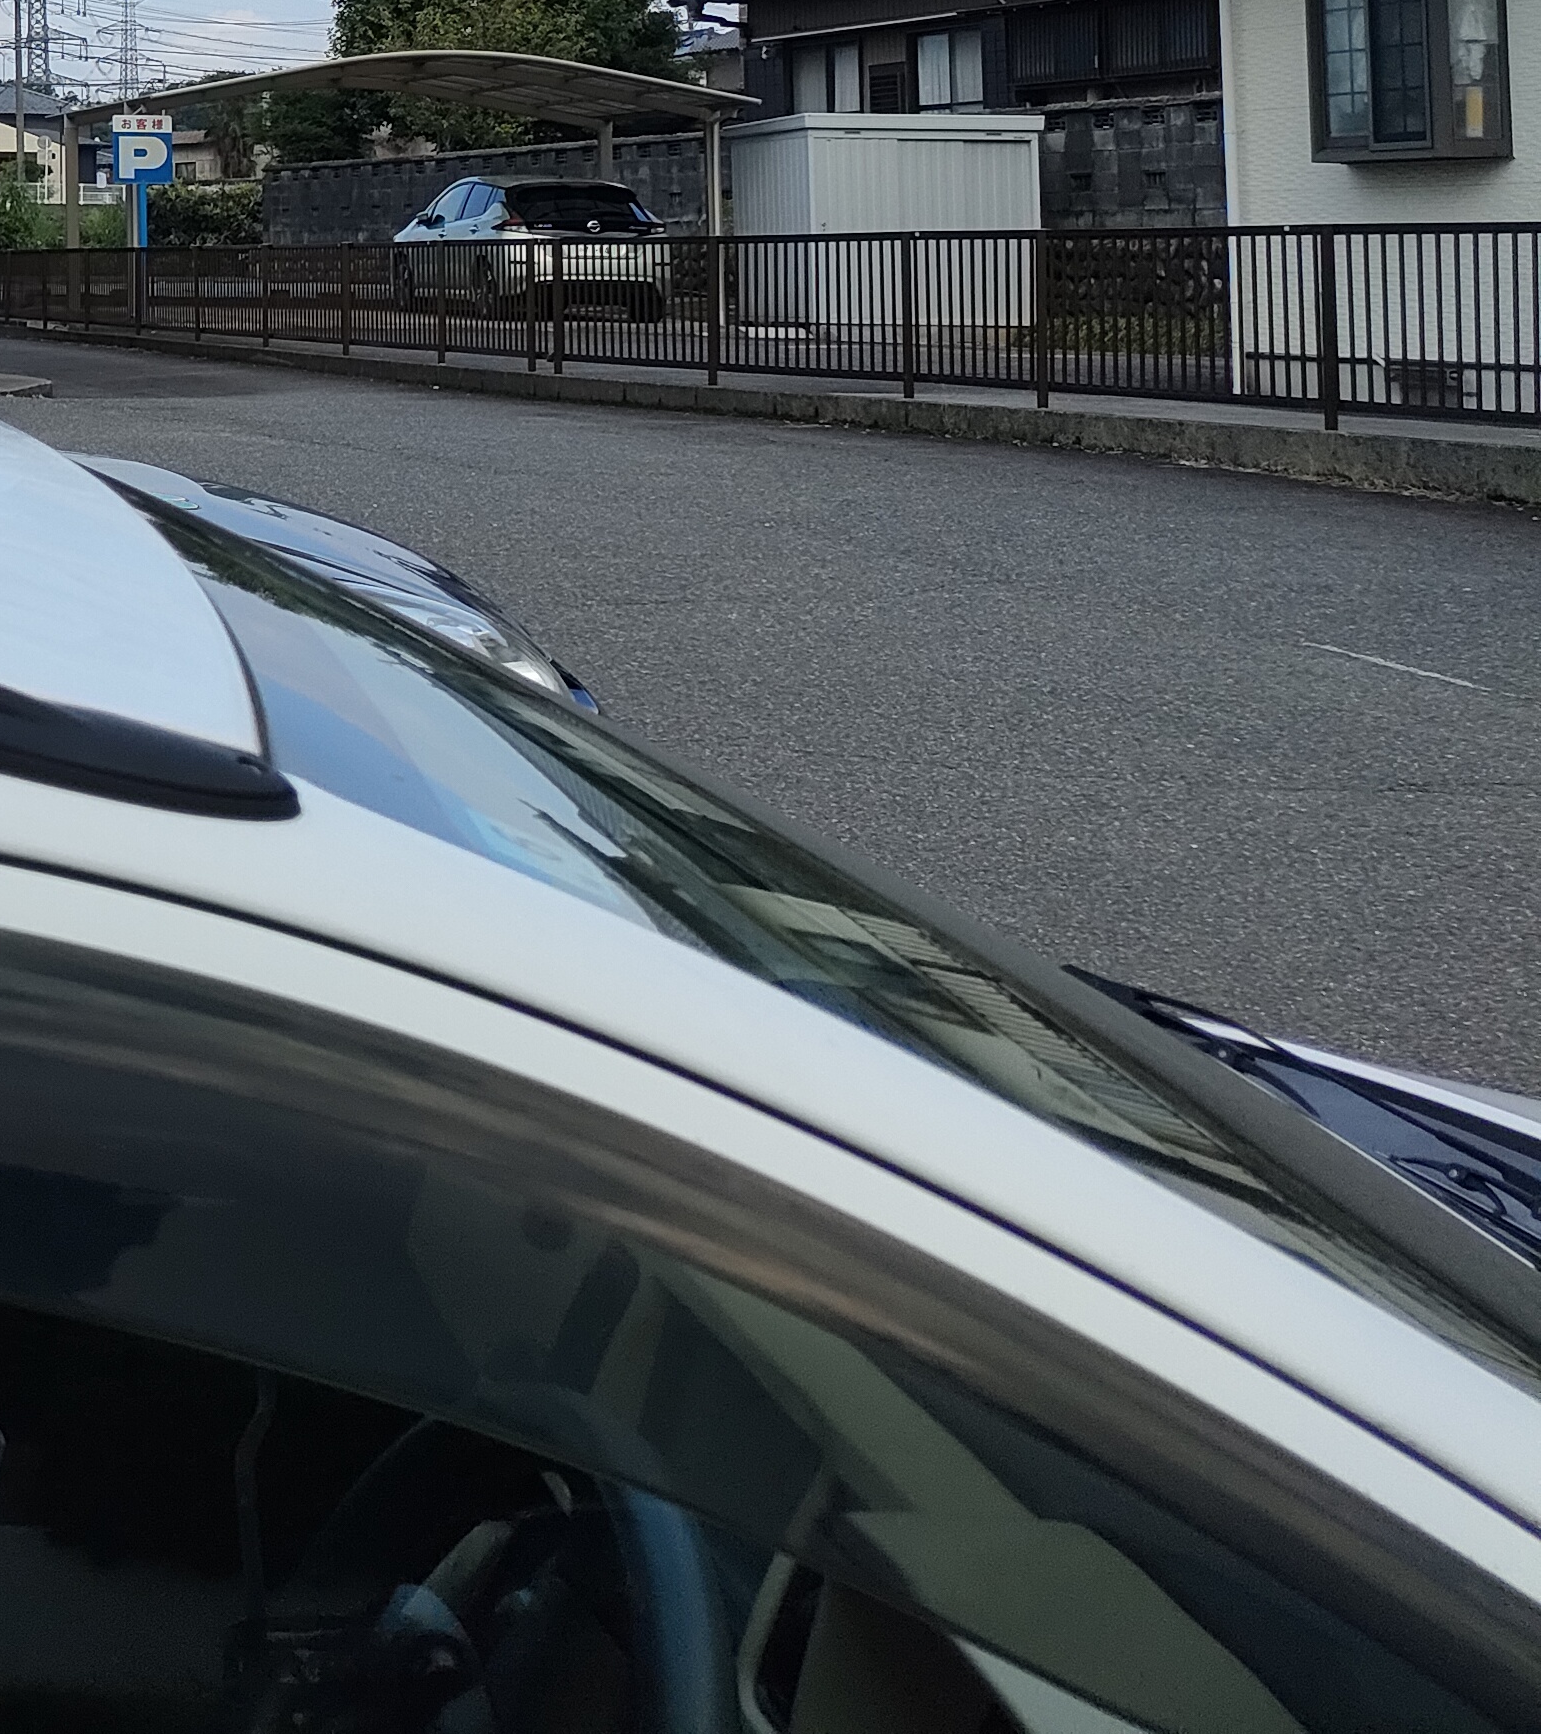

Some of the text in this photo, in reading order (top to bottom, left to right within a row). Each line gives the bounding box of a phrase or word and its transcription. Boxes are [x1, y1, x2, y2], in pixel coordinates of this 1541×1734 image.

[121, 118, 163, 130] お客様
[119, 136, 168, 179] P
